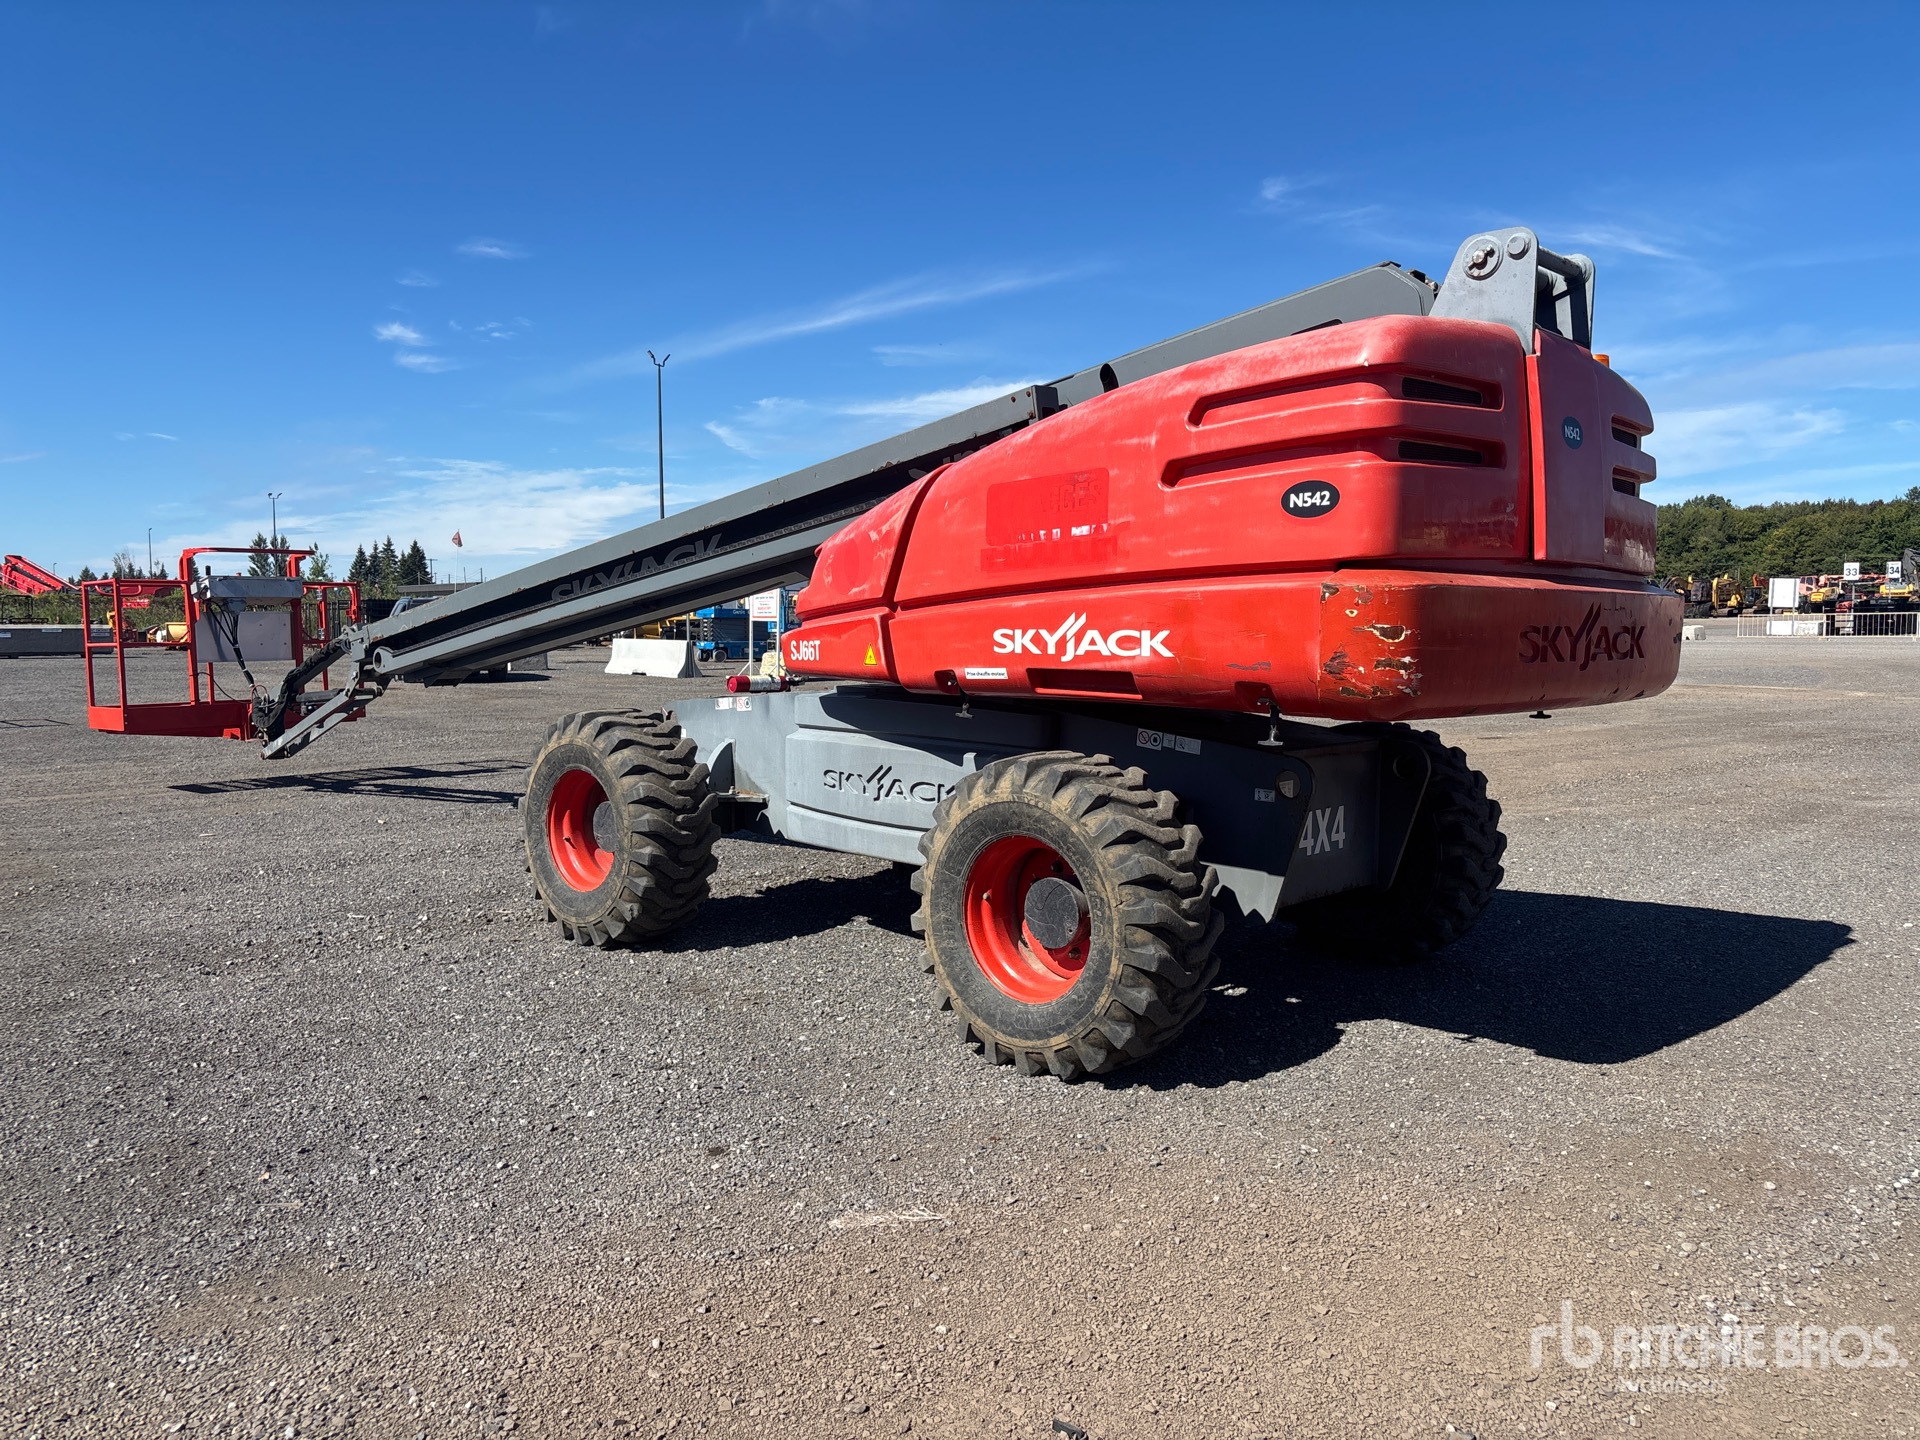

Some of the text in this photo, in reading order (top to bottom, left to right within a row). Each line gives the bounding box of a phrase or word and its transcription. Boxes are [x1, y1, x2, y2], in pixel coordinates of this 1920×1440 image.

[1564, 425, 1580, 441] N542
[1289, 490, 1331, 508] N542
[1845, 568, 1858, 576] 33
[1889, 566, 1900, 574] 34
[993, 611, 1175, 662] SKYJACK
[1518, 602, 1645, 672] SKYJACK
[790, 640, 821, 661] SJ66T
[1299, 805, 1346, 856] 4X4
